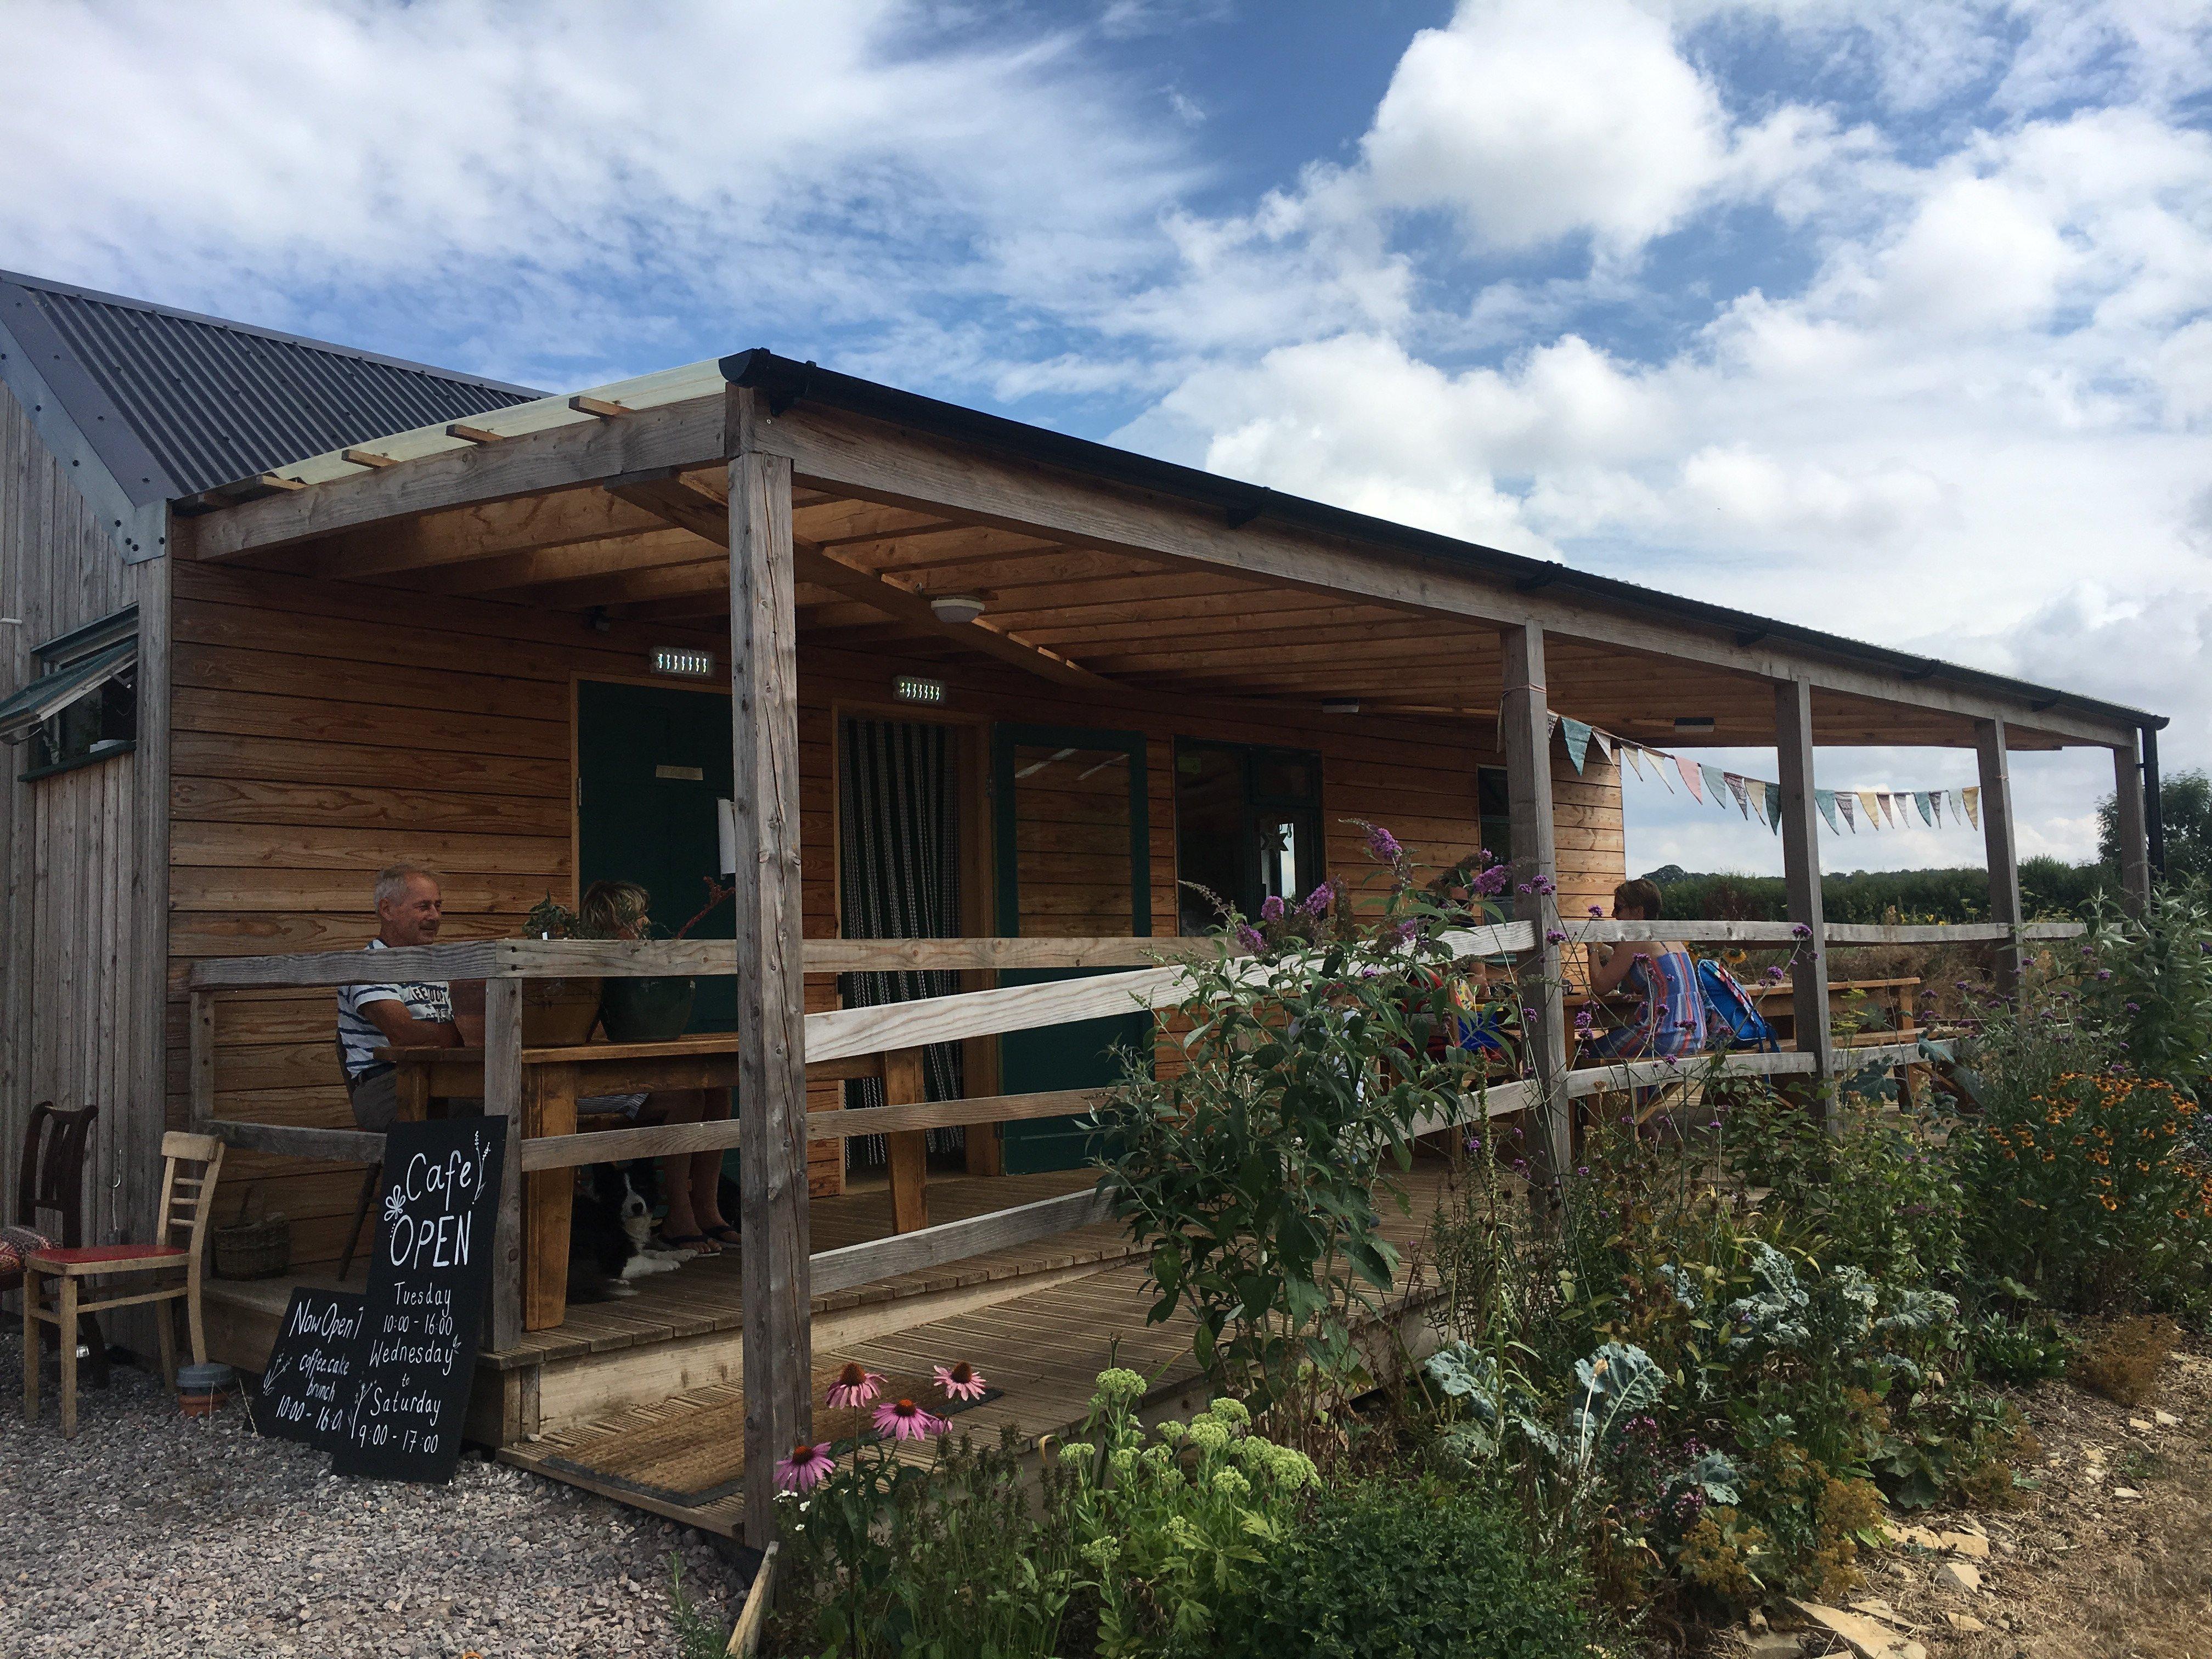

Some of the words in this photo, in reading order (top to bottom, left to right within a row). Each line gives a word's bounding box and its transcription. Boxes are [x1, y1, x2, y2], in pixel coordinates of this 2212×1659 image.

[406, 1149, 472, 1211] Cafe
[390, 1210, 472, 1269] OPEN
[289, 1298, 322, 1338] Now
[394, 1281, 452, 1318] Tuesday
[382, 1314, 409, 1333] 10:00
[424, 1313, 453, 1335] 16:00
[368, 1338, 454, 1376] Wednesday
[306, 1377, 336, 1402] brunch
[401, 1373, 410, 1387] to
[275, 1395, 305, 1422] 10:00
[315, 1406, 343, 1432] 16:0
[370, 1387, 441, 1426] Saturday
[359, 1424, 388, 1448] 9:00
[402, 1430, 438, 1454] 17:00
